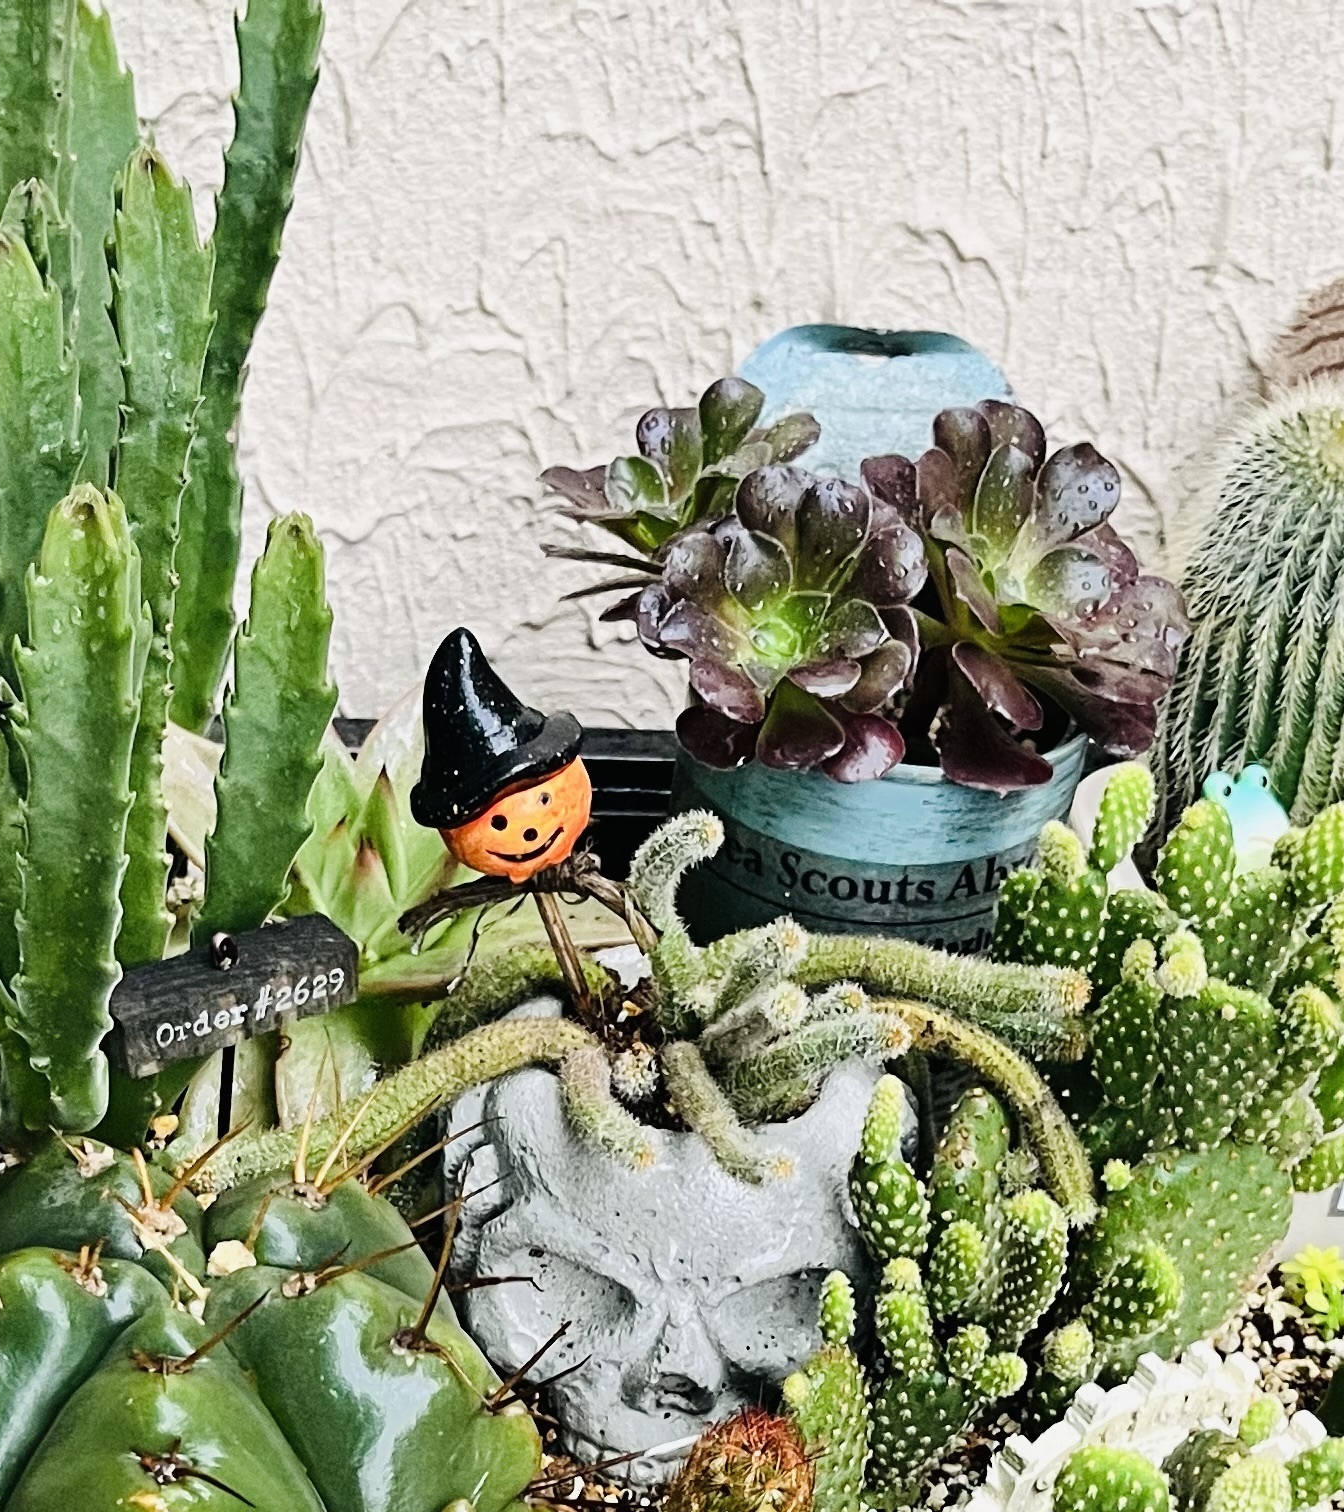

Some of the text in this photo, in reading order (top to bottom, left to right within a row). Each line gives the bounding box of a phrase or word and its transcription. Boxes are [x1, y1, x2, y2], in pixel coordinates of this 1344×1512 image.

[779, 851, 936, 904] Scouts
[155, 967, 346, 1048] Order #2629
